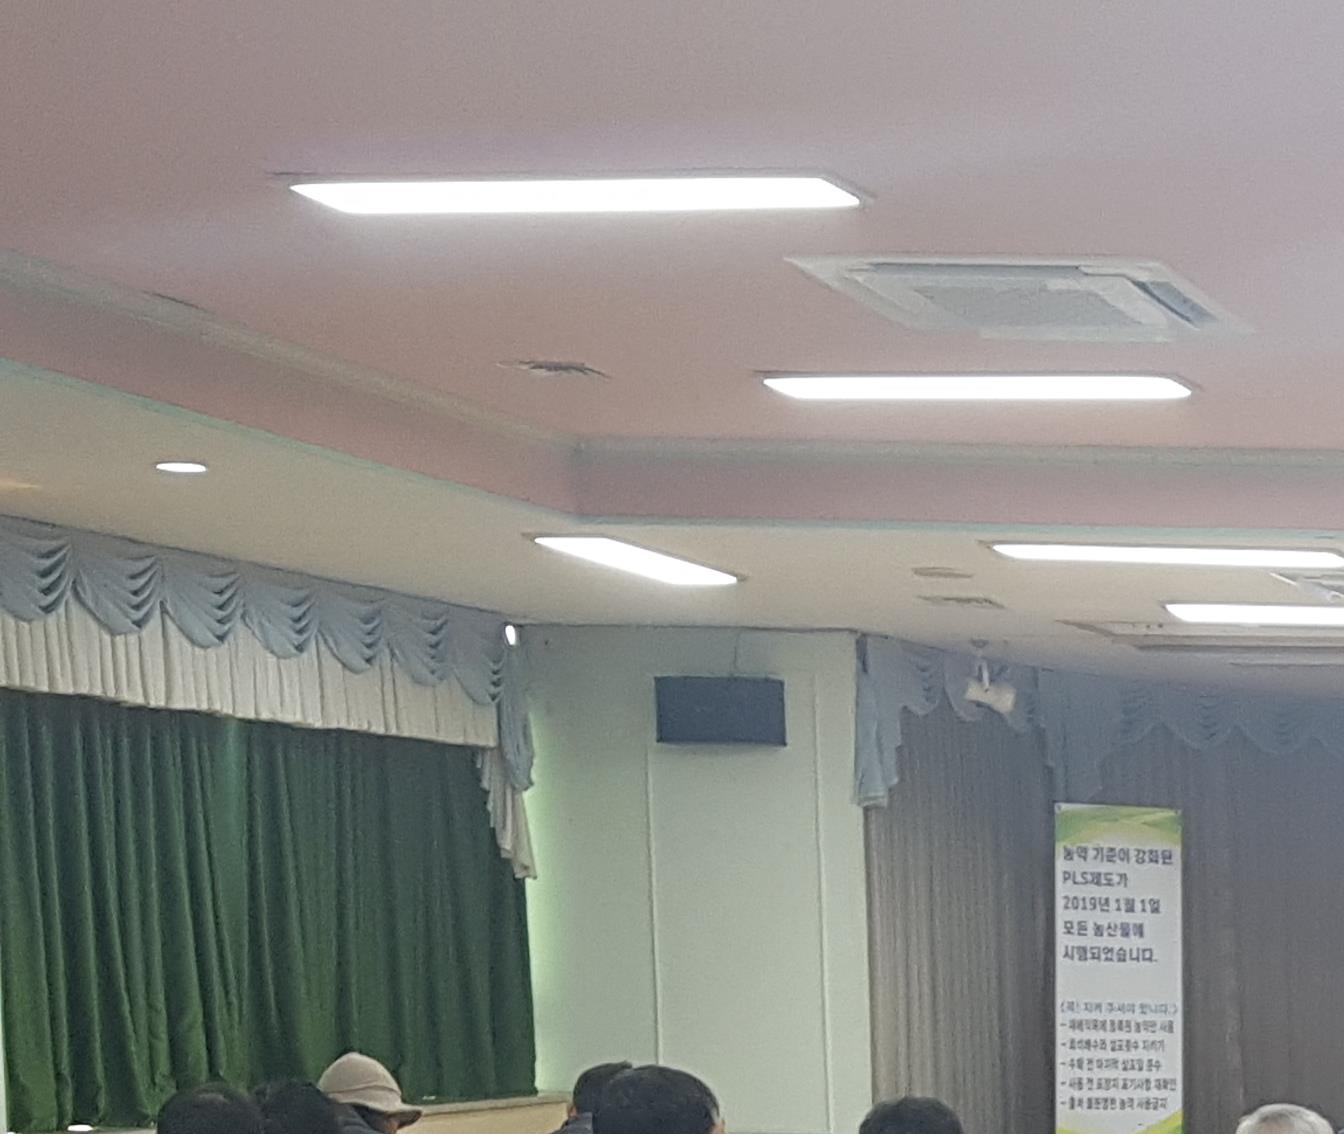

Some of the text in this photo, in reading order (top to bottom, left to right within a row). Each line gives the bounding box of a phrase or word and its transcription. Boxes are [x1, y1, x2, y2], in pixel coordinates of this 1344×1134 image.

[1063, 845, 1174, 866] 농약 기준이 강화된
[1062, 870, 1129, 888] PLS제도가
[1063, 895, 1162, 915] 2019년 1월 1일
[1063, 920, 1145, 939] 모든 농산물에
[1063, 945, 1159, 963] 시행되었습니다.
